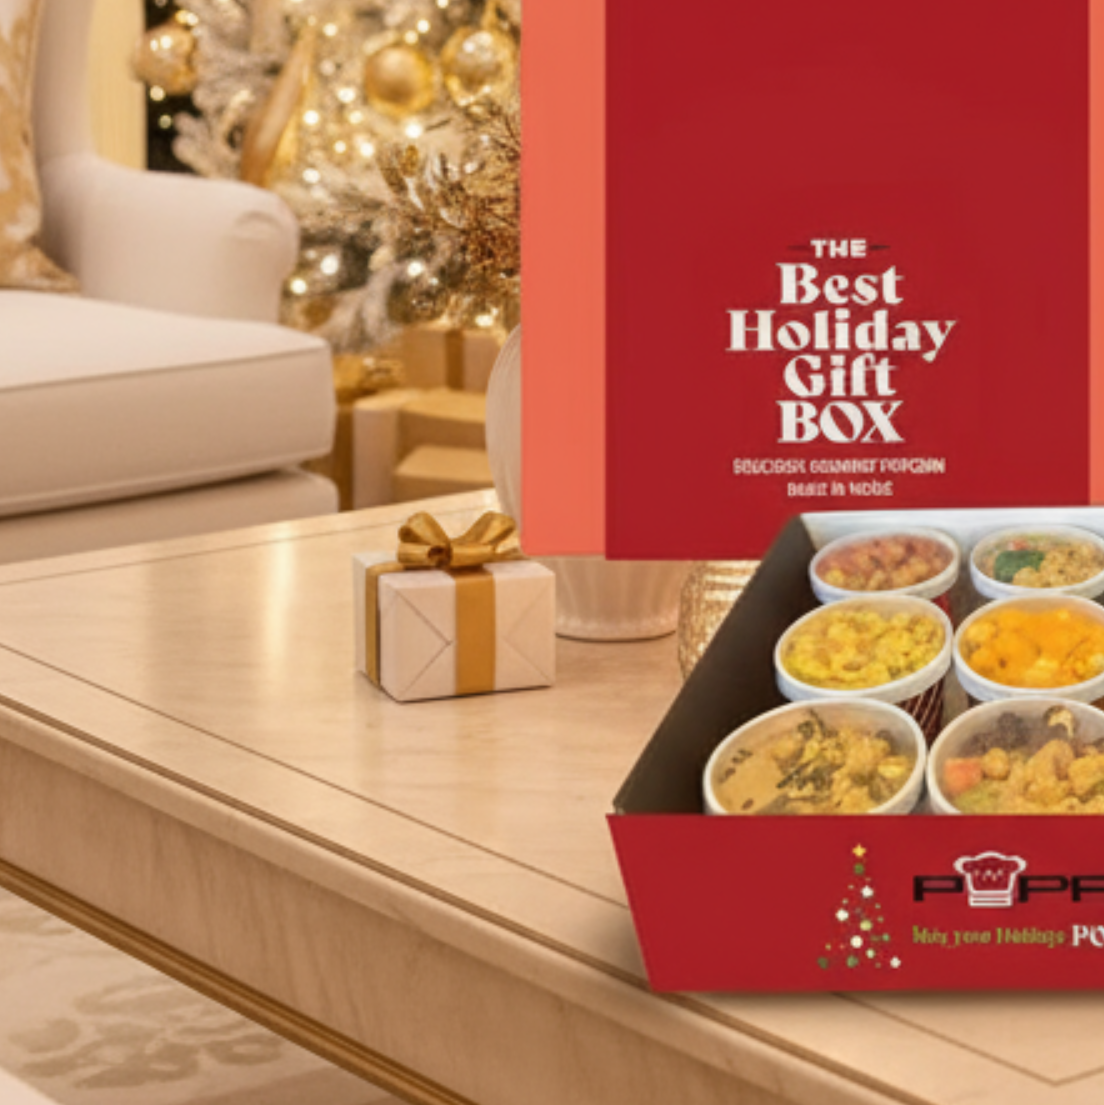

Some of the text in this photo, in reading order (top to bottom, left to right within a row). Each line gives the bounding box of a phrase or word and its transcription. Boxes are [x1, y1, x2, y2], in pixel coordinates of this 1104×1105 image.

[810, 239, 867, 258] THE
[776, 262, 904, 305] Best
[726, 307, 957, 363] Holiday
[783, 353, 897, 398] Gift
[776, 399, 905, 443] BOX
